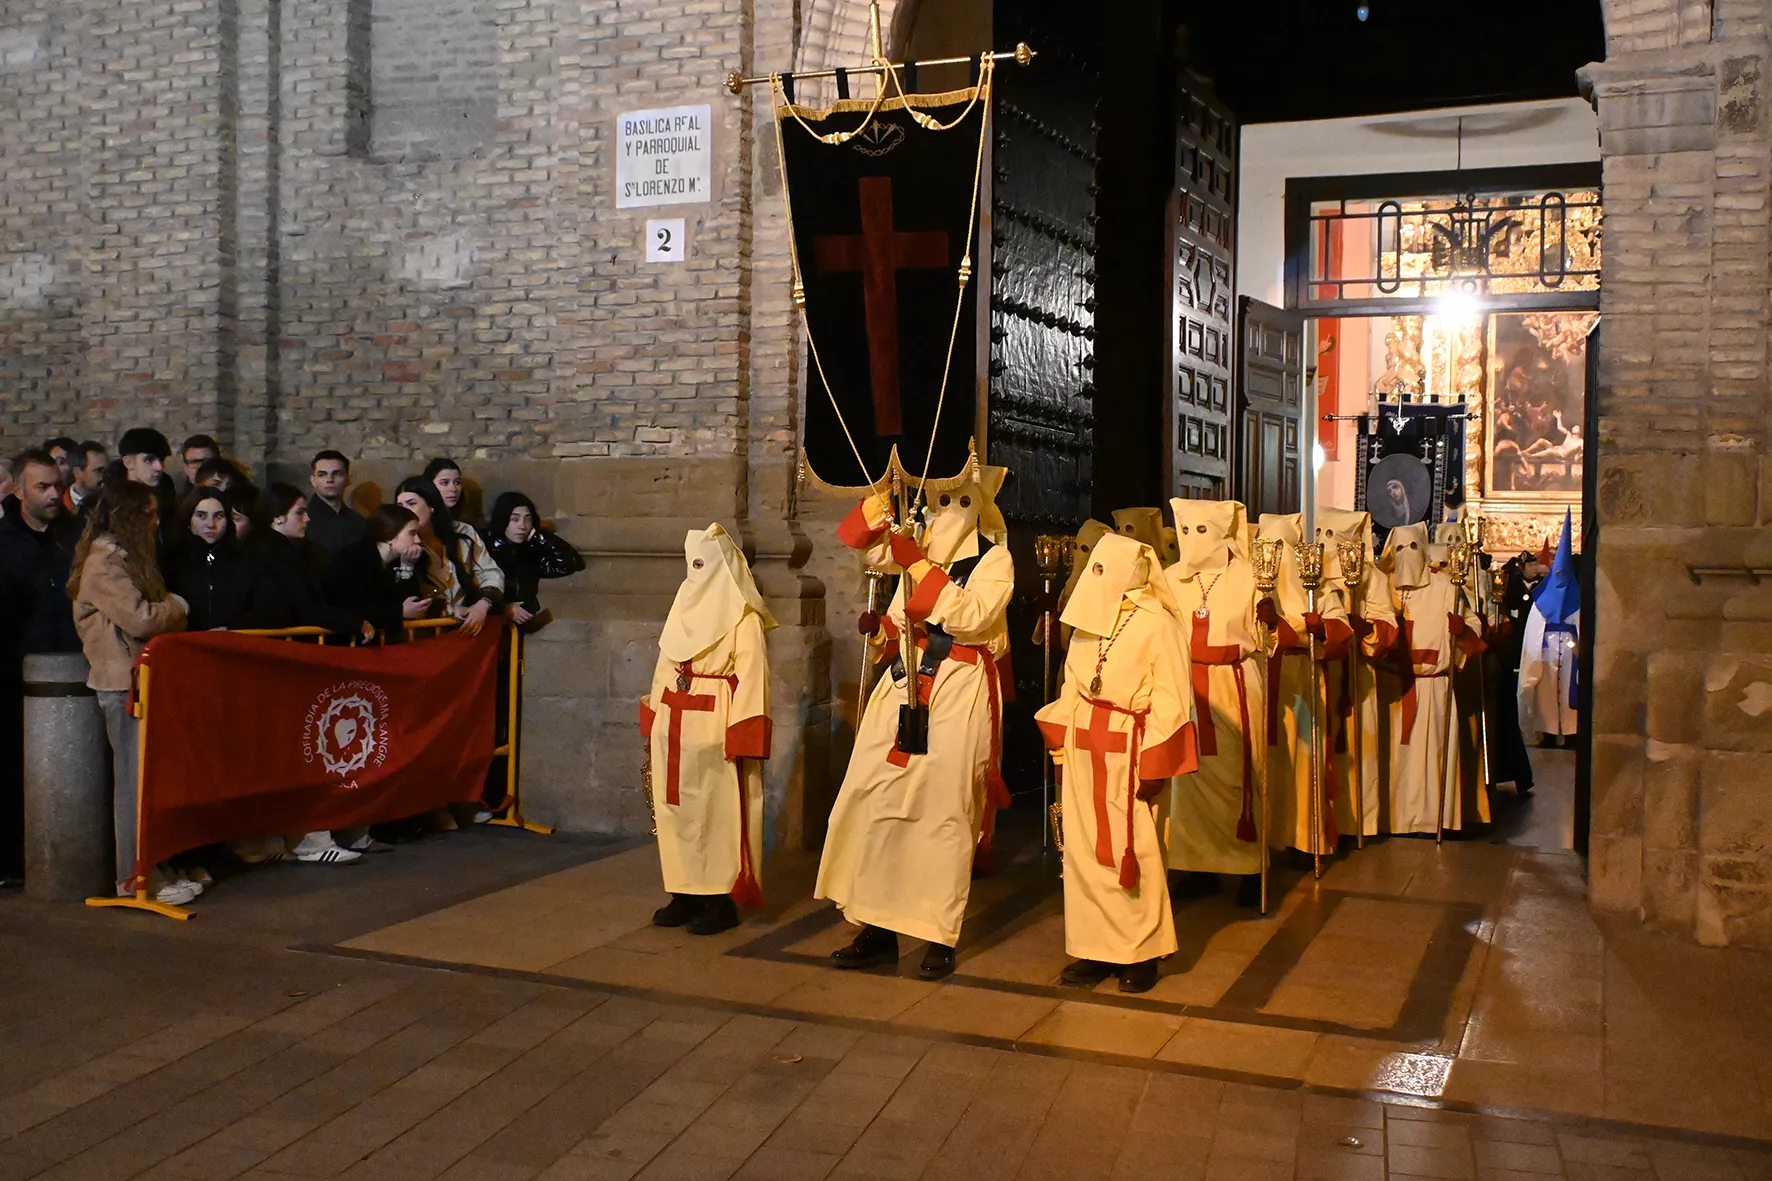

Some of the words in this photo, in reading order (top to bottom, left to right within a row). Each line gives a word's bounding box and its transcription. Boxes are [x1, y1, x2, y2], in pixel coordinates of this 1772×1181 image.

[625, 142, 632, 156] Y
[636, 136, 701, 156] PARROQUIAL
[655, 158, 669, 175] DE
[636, 177, 685, 197] LORENZO
[657, 228, 672, 252] 2
[316, 688, 331, 704] DE
[332, 682, 346, 693] LA
[372, 722, 388, 768] SANGRE
